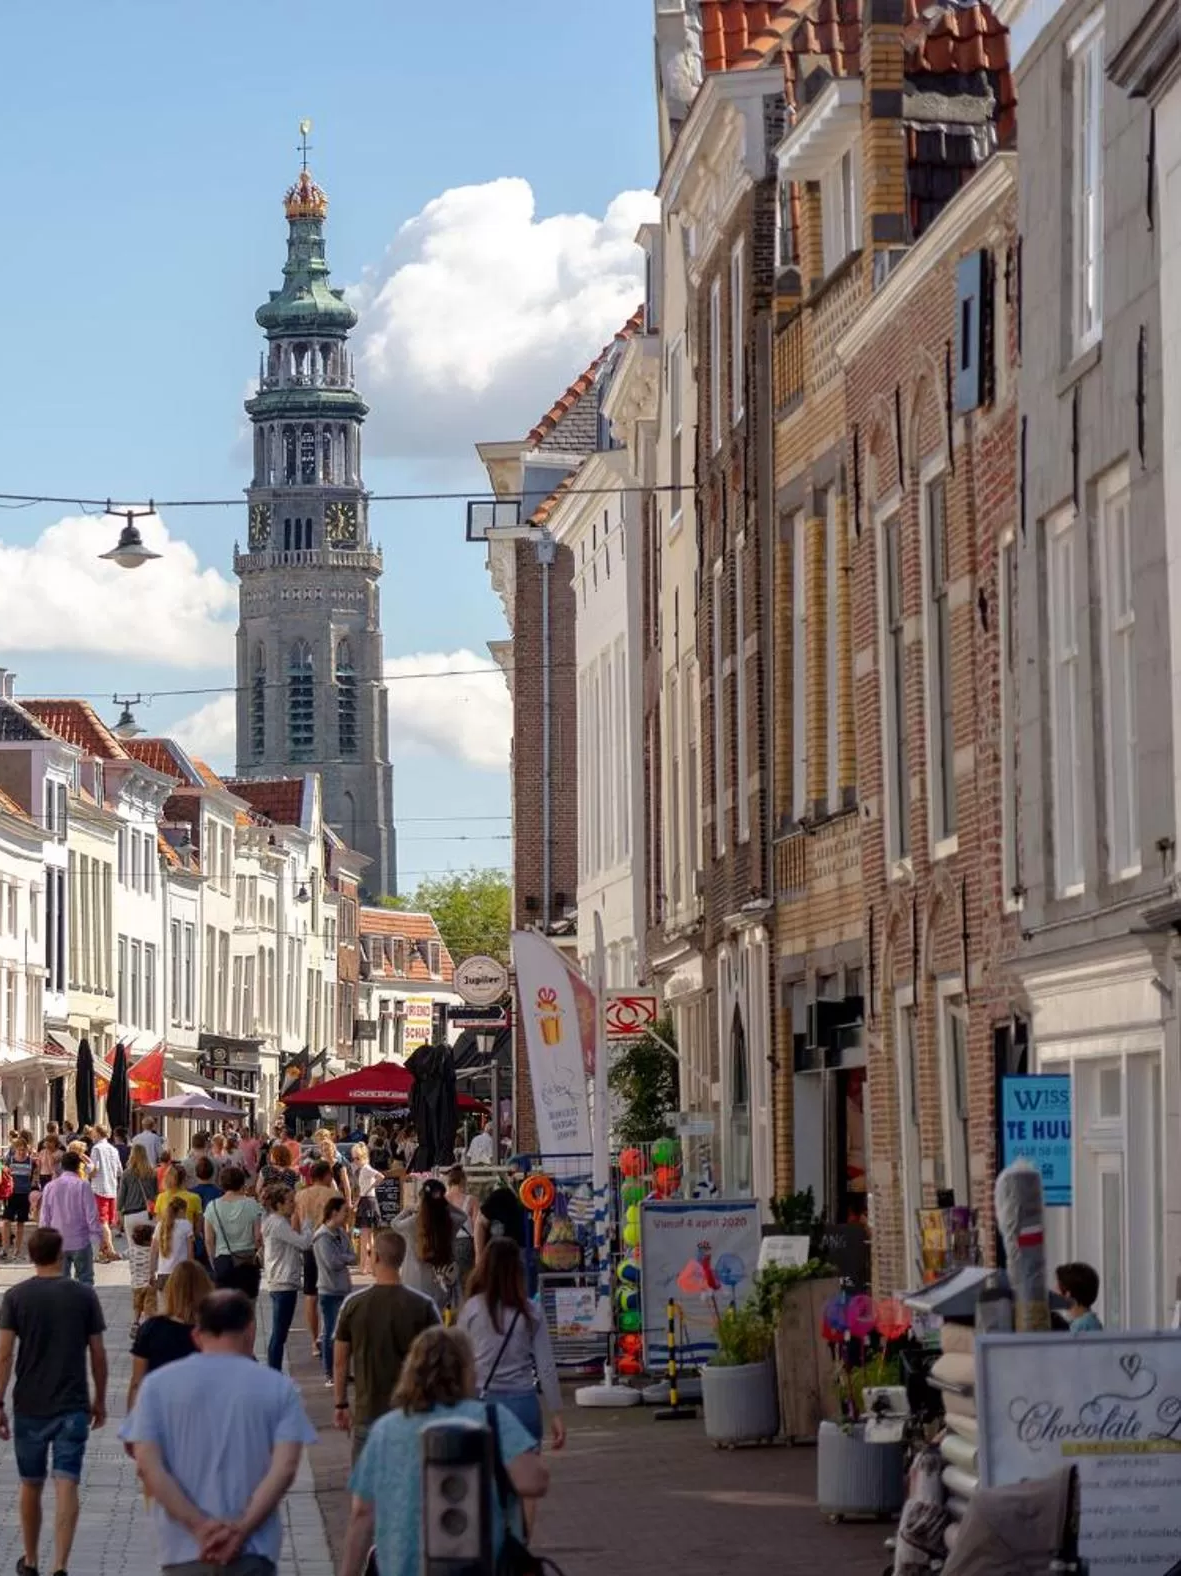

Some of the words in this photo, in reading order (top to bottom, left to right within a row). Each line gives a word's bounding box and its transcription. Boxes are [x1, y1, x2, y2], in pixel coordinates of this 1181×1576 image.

[464, 975, 500, 986] Jupiler
[1007, 1120, 1027, 1140] TE
[1009, 1396, 1143, 1451] Chocolate
